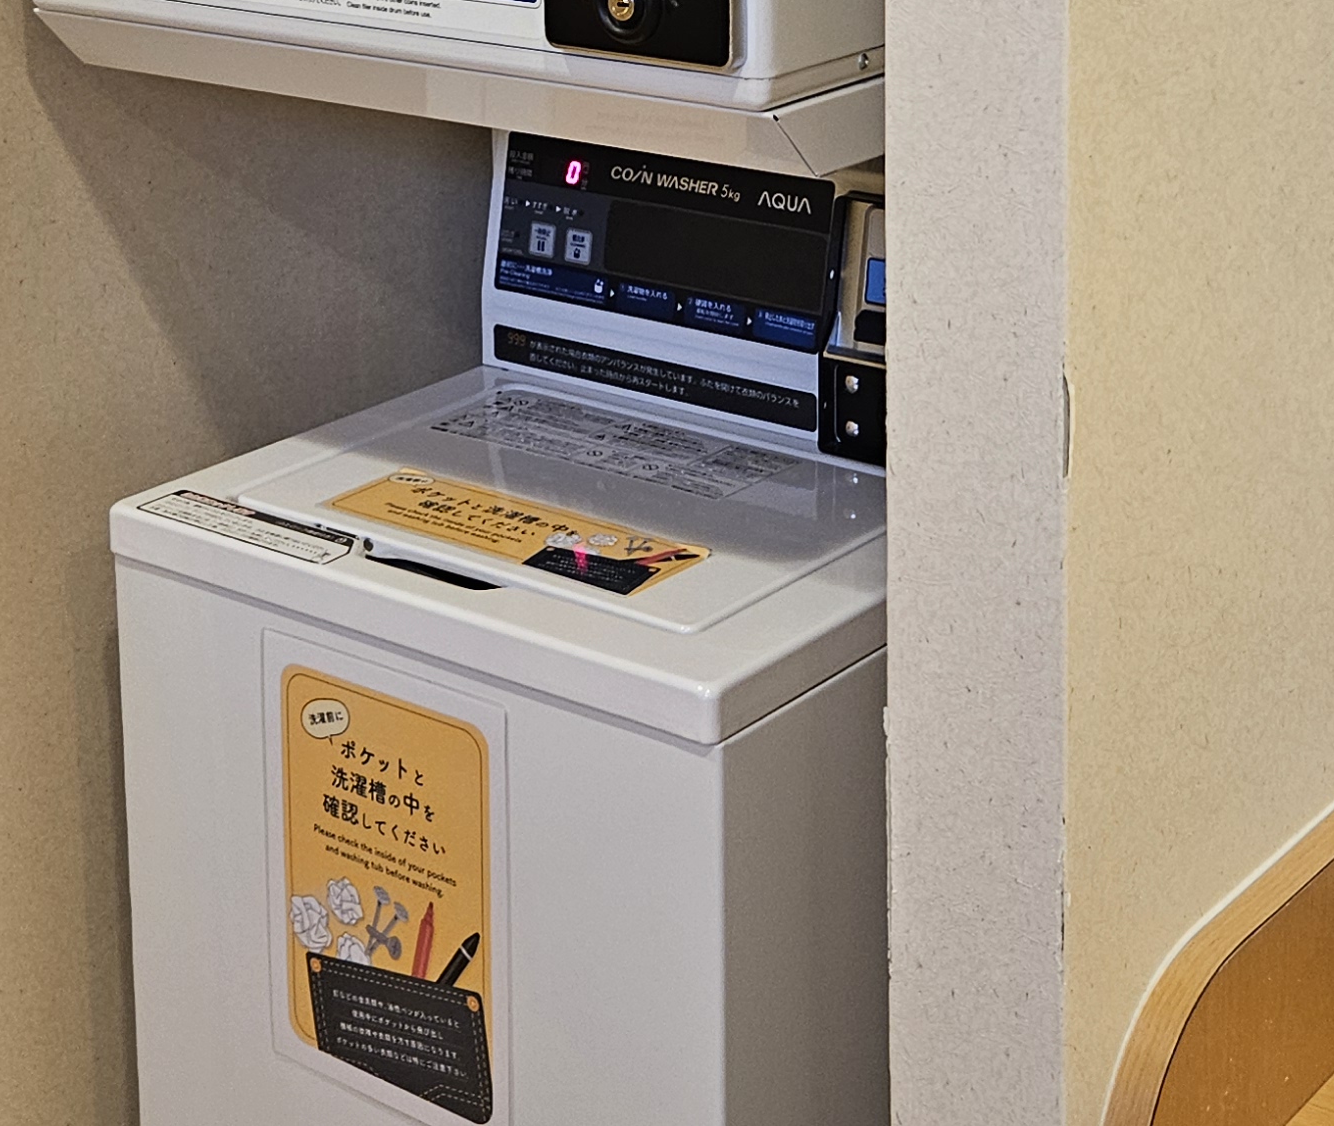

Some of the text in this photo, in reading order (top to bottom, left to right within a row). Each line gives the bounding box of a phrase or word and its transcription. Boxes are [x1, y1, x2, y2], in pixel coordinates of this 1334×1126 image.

[565, 160, 582, 185] 0
[656, 173, 718, 197] WASHER
[720, 184, 741, 203] 5kg
[757, 191, 812, 215] AQUA
[308, 711, 344, 725] 洗濯前に
[340, 740, 424, 787] ポケットと
[330, 764, 435, 822] 洗濯槽の中を
[322, 793, 446, 855] 確認してください
[313, 823, 457, 887] Please check the inside of your pockets
[325, 844, 339, 856] and
[340, 849, 370, 870] washing
[371, 861, 384, 873] tub
[385, 865, 410, 884] before
